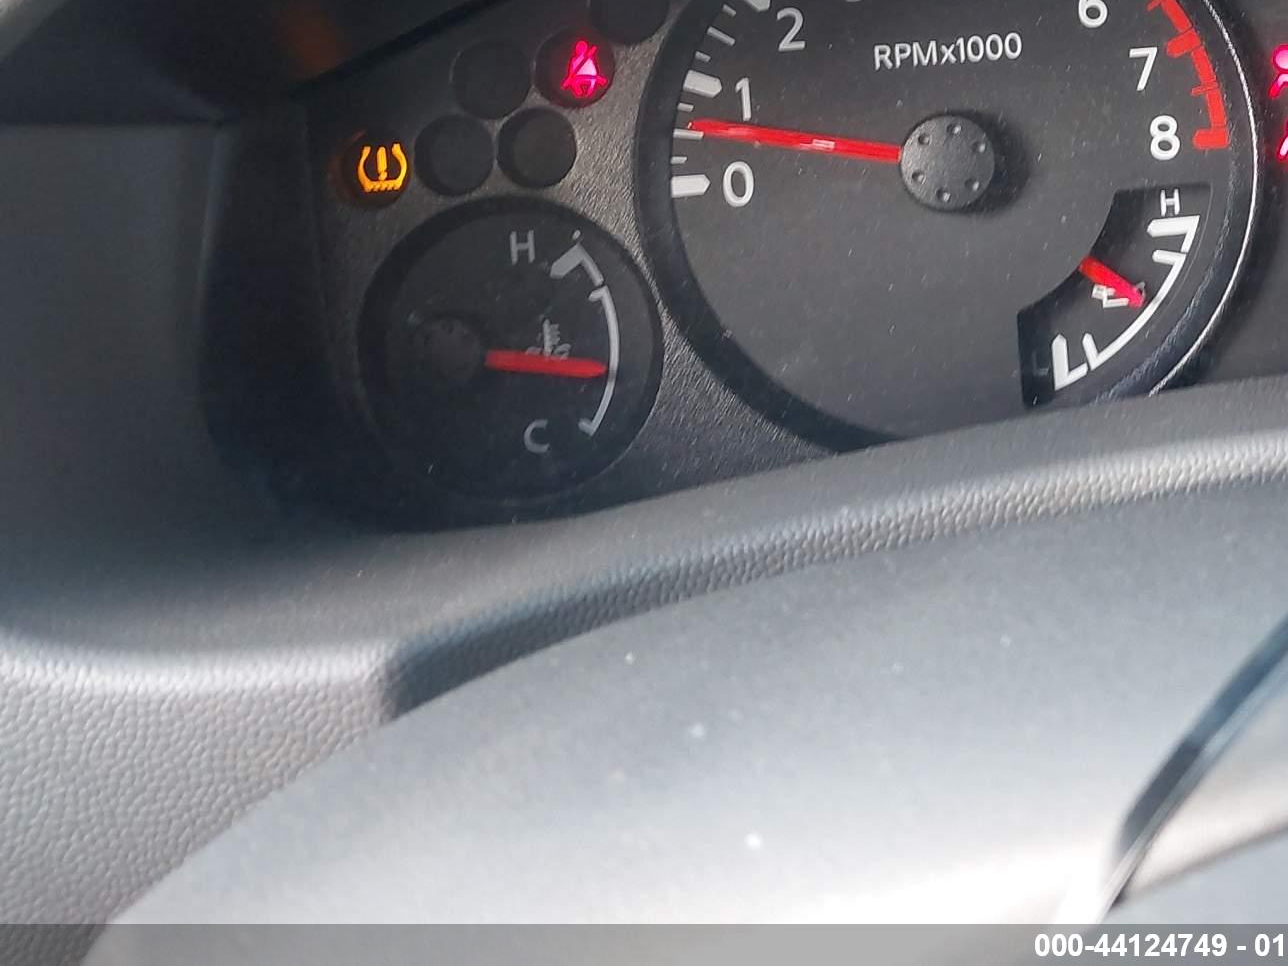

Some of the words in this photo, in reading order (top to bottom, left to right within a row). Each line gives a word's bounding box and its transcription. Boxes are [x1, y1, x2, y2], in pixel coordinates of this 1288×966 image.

[776, 7, 805, 51] 2
[873, 32, 1022, 70] RPMx1000
[1128, 46, 1158, 91] 7
[734, 77, 752, 121] 1
[1149, 115, 1180, 160] 8
[722, 162, 755, 207] 0
[1159, 188, 1181, 217] H
[508, 230, 535, 264] H
[523, 419, 550, 454] C
